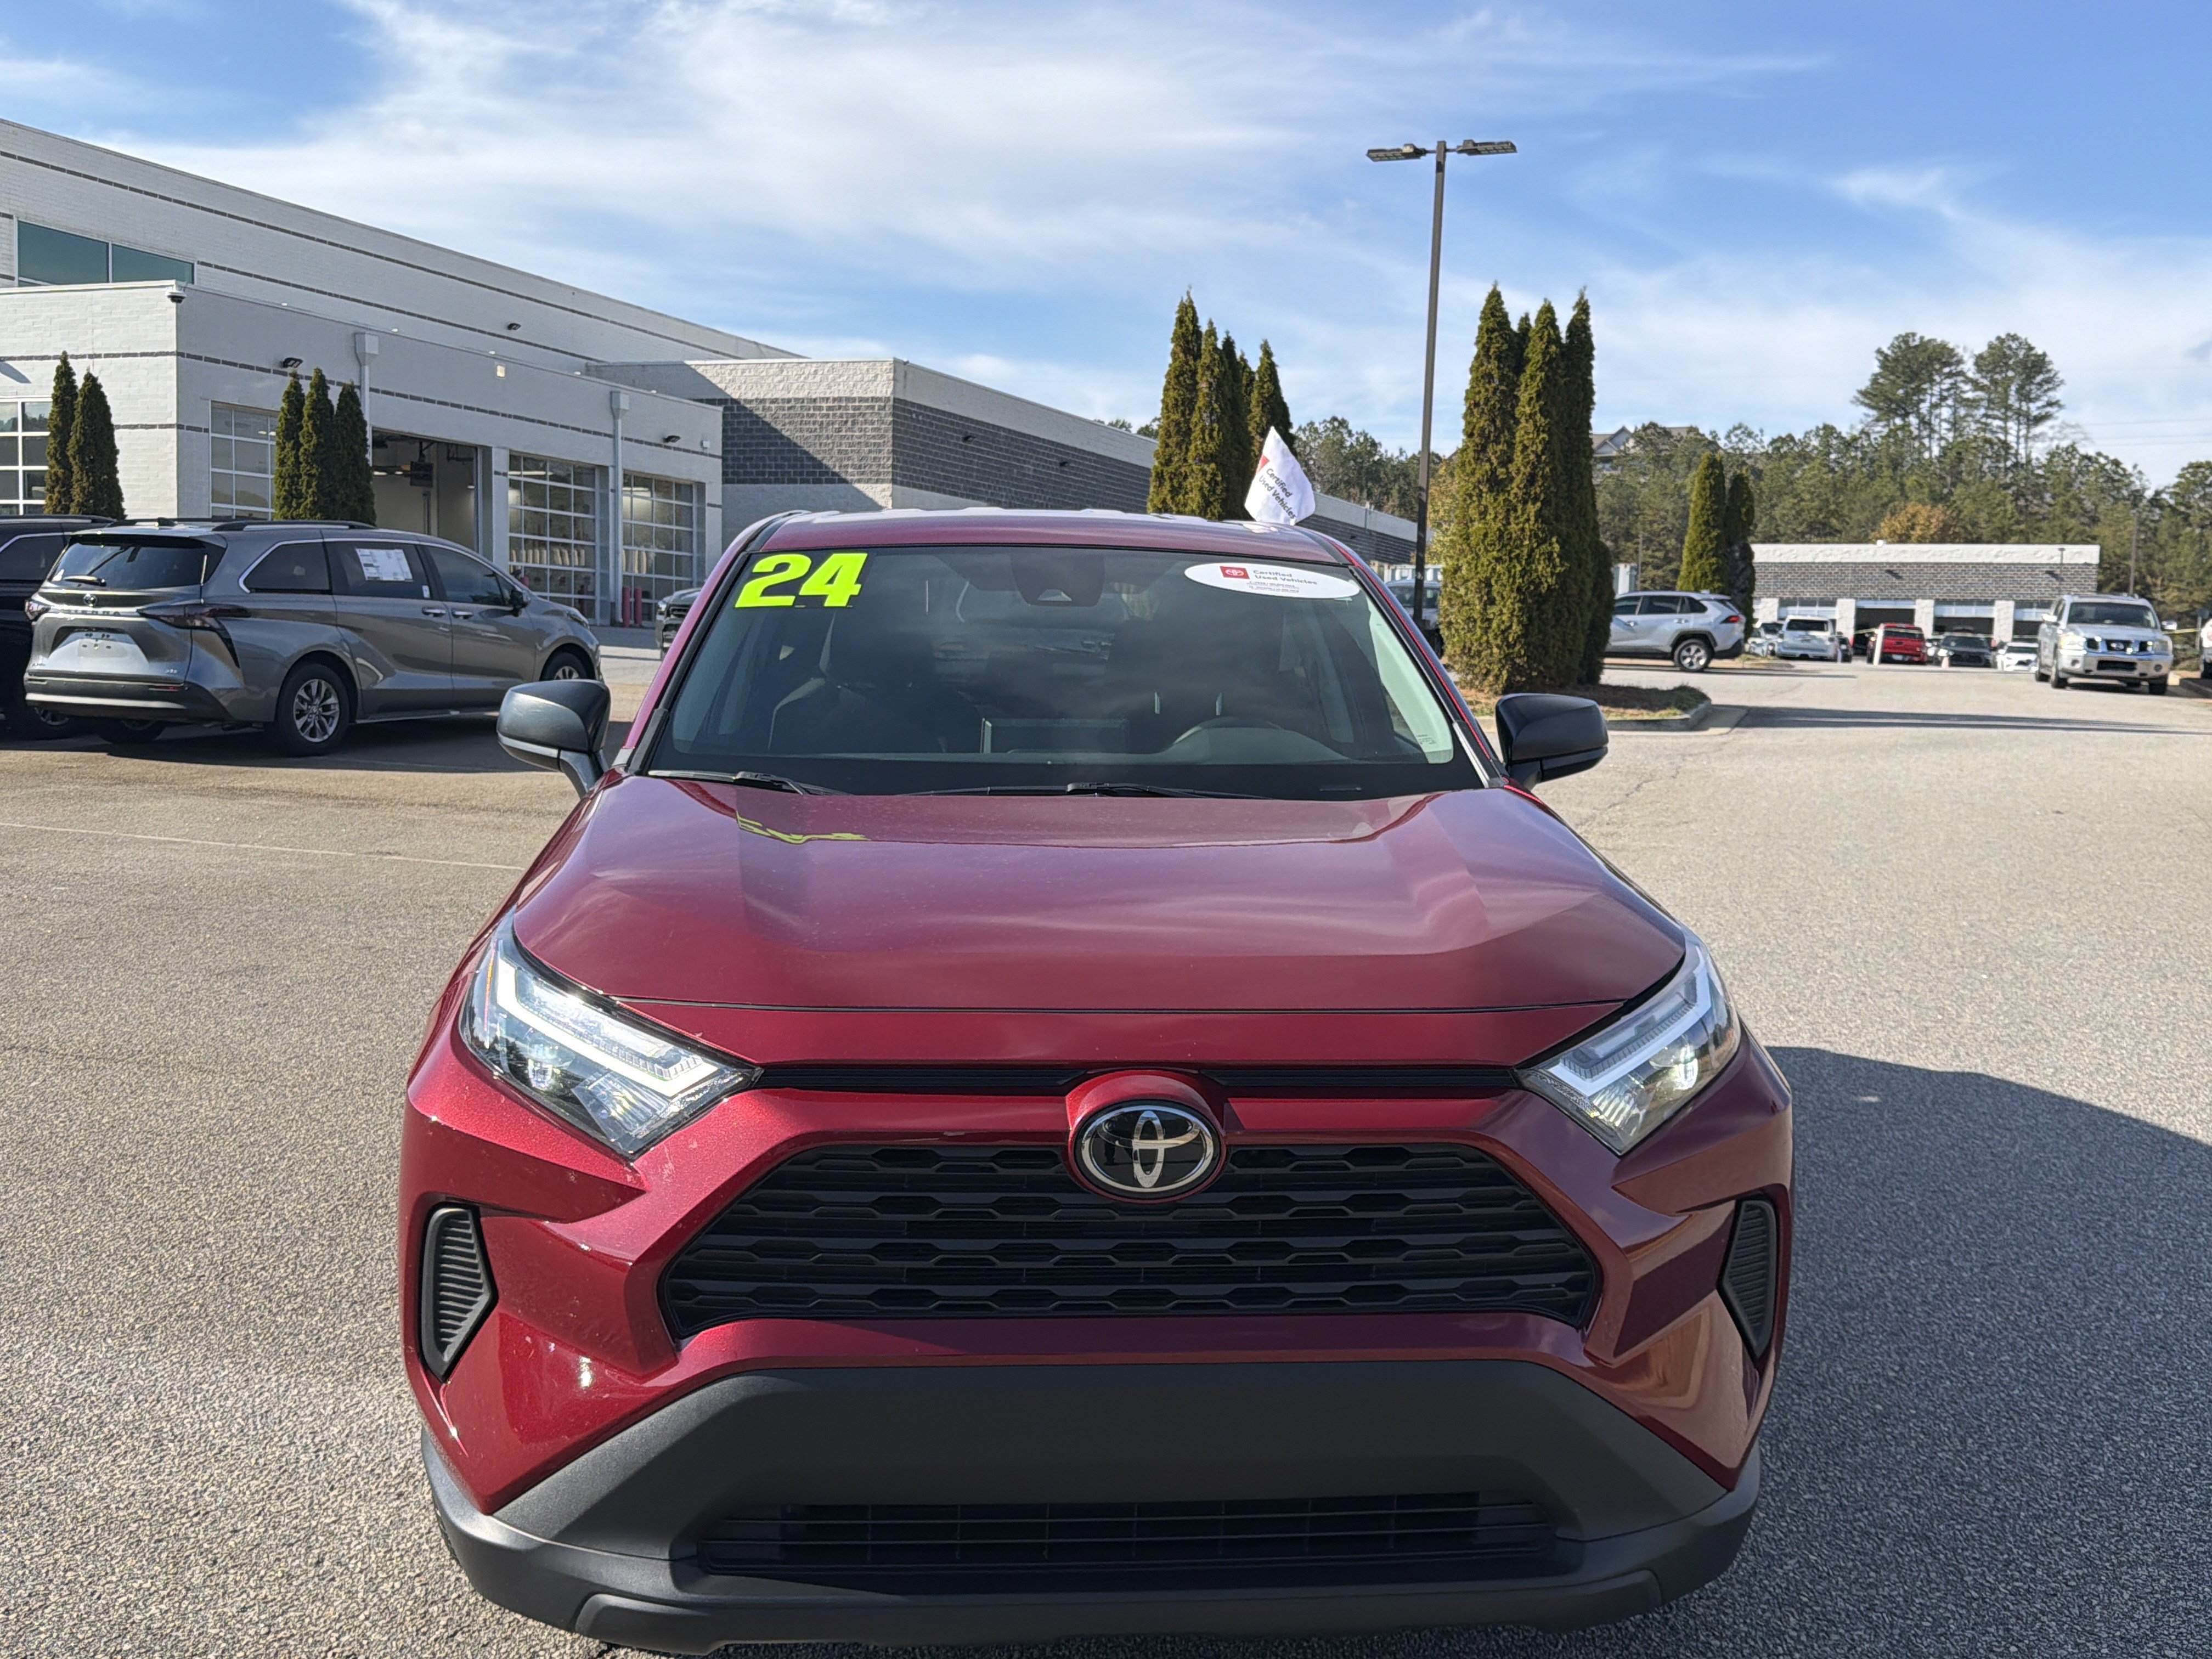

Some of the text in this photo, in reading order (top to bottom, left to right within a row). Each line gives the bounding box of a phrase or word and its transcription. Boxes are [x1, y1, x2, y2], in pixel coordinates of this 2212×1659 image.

[1259, 475, 1296, 519] Used Vehicles
[1266, 468, 1293, 498] Certified
[735, 553, 868, 608] 24
